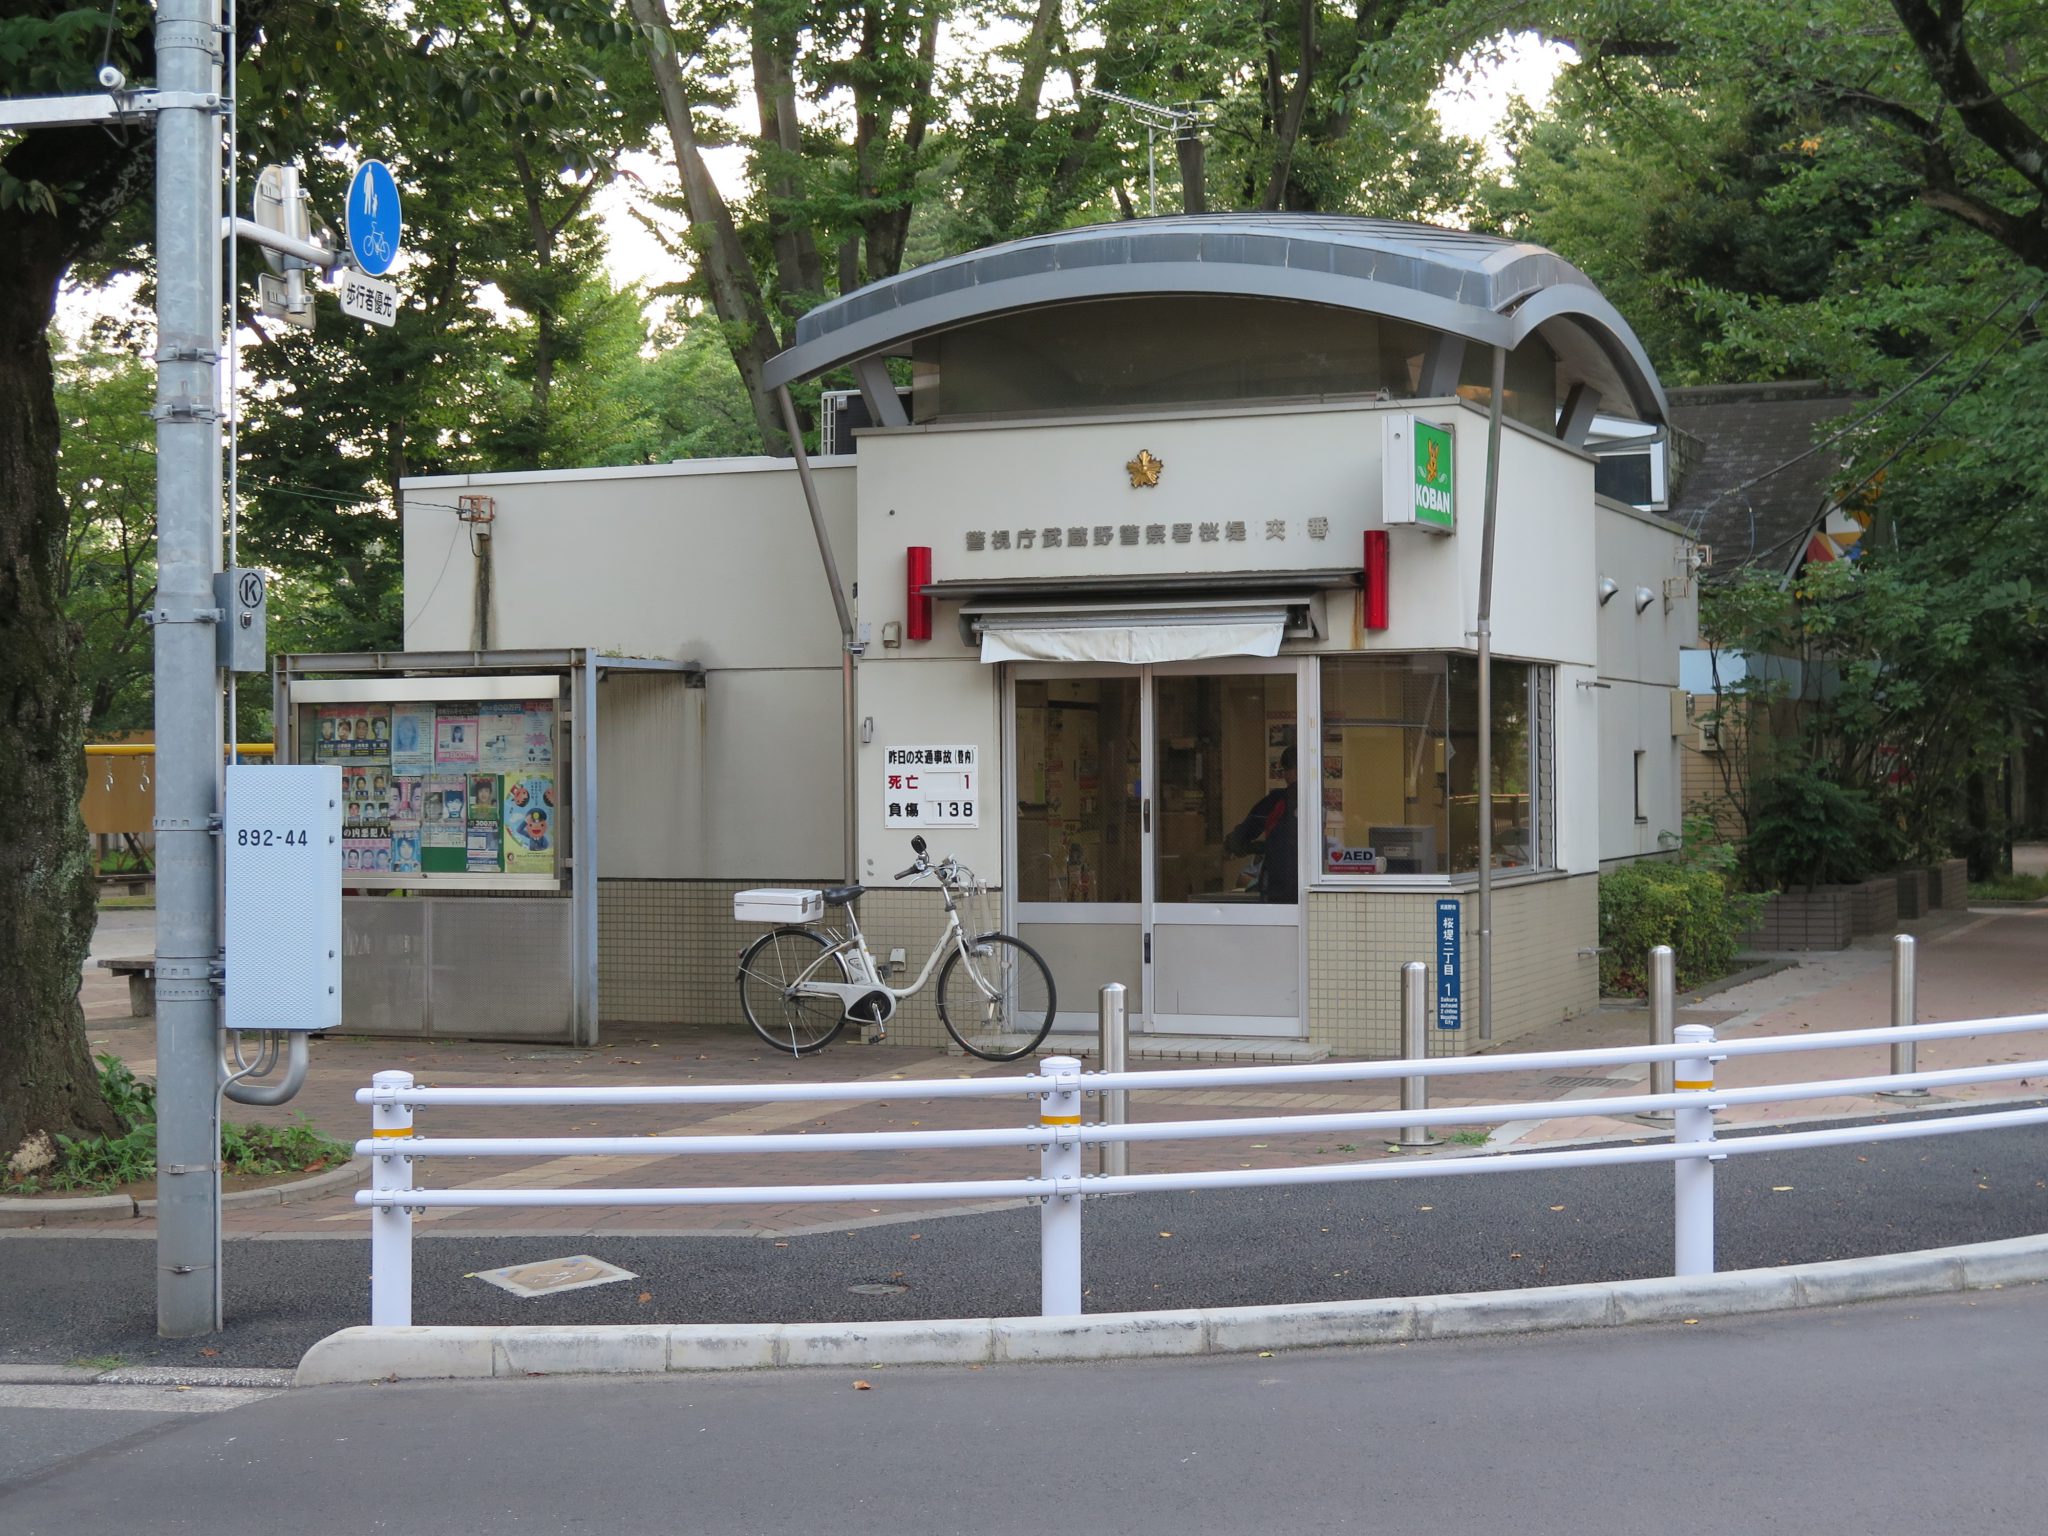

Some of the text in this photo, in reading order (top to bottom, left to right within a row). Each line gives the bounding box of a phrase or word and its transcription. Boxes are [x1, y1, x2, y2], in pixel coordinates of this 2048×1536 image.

[346, 283, 392, 317] 歩行者優先
[1415, 484, 1451, 514] KOBAN
[888, 775, 919, 789] 死亡
[888, 802, 973, 817] 負傷 138
[238, 829, 308, 847] 892-44
[1343, 851, 1373, 861] AED
